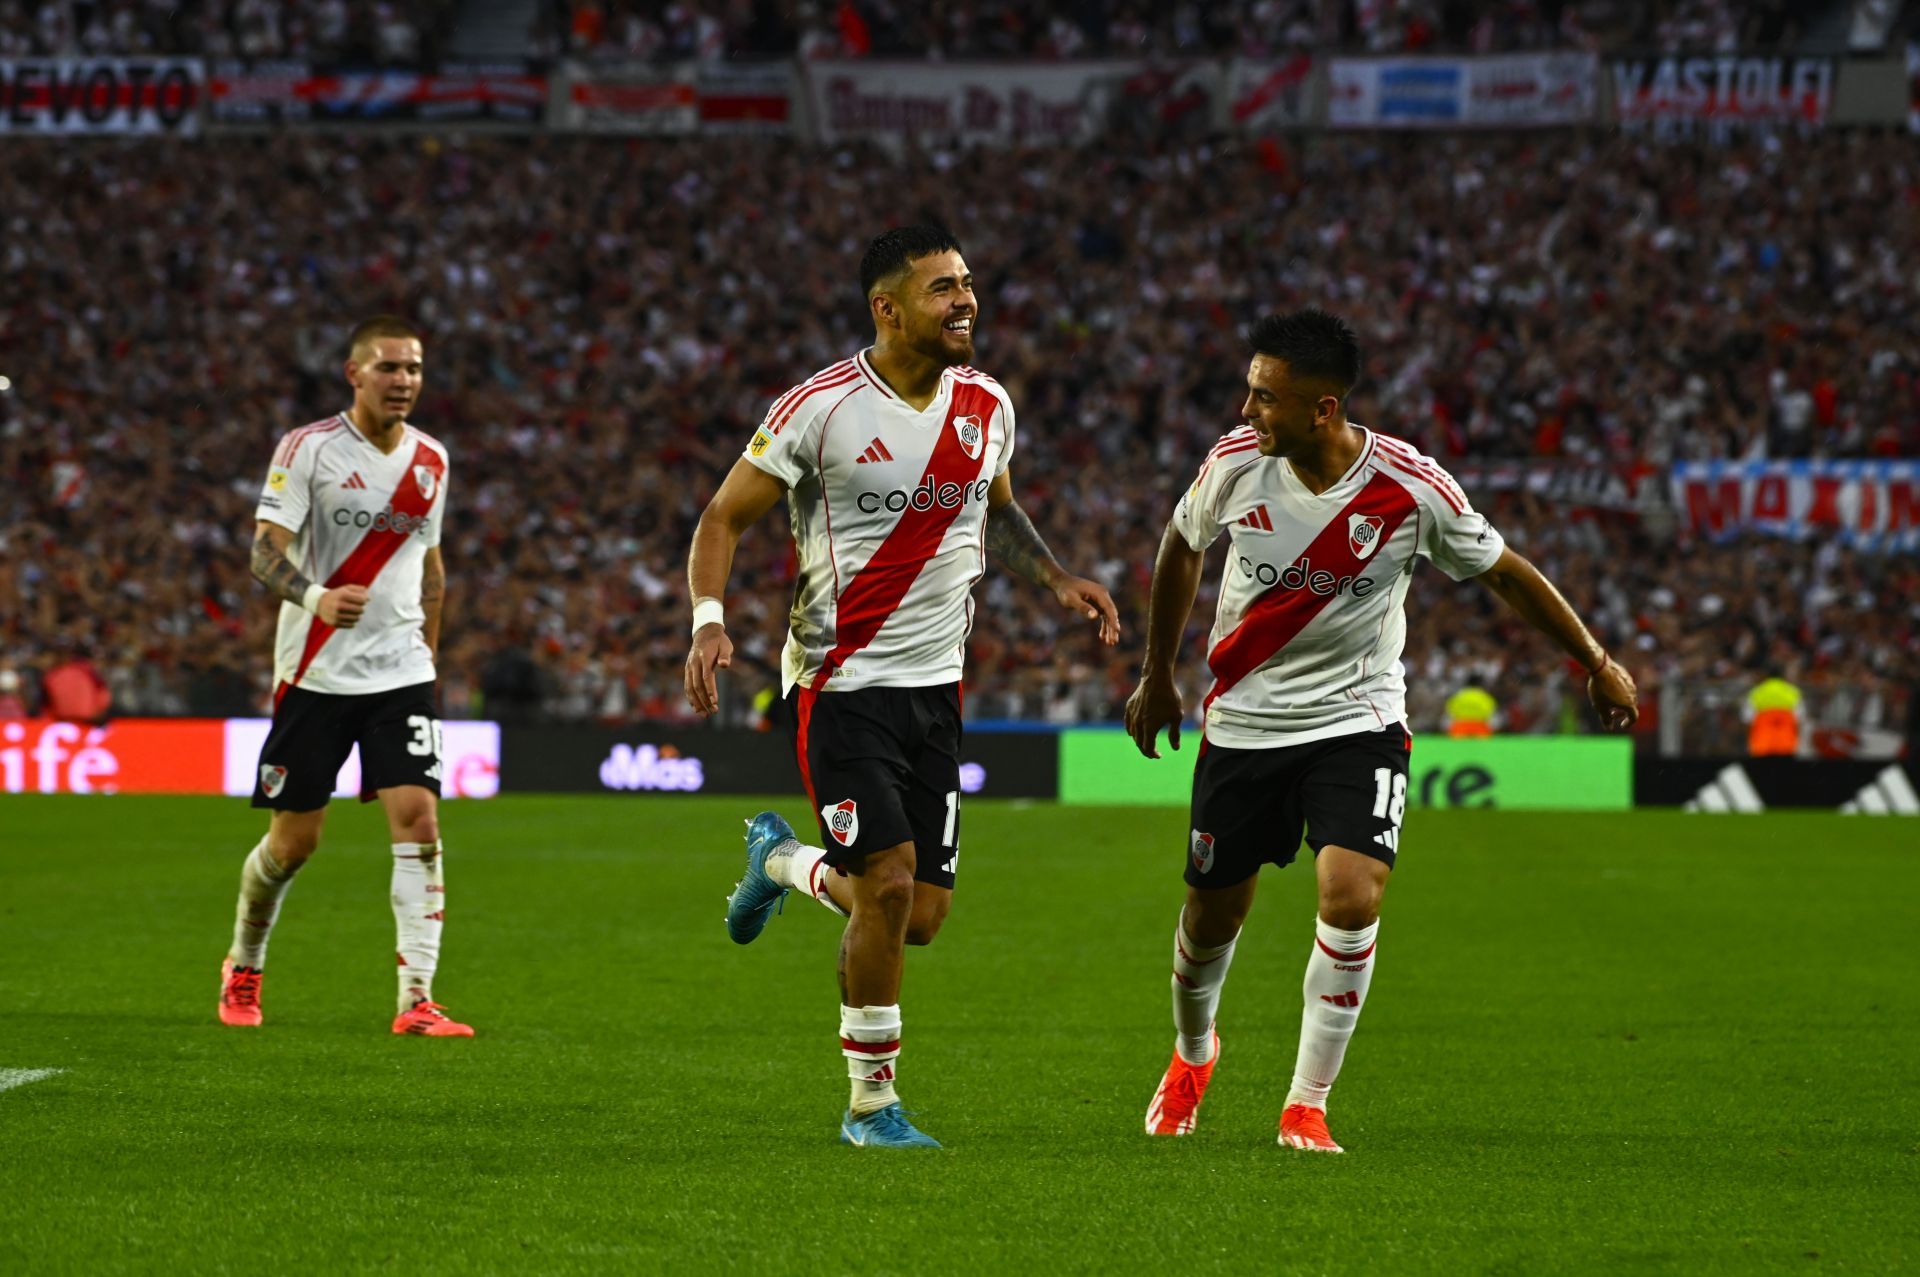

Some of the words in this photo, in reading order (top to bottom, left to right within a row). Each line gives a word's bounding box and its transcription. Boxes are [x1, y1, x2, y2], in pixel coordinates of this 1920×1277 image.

[0, 64, 194, 126] EVOTO
[856, 474, 989, 514] codere
[333, 503, 430, 536] codere
[1239, 556, 1376, 599] codere
[942, 790, 961, 848] 1
[1372, 767, 1407, 829] 18
